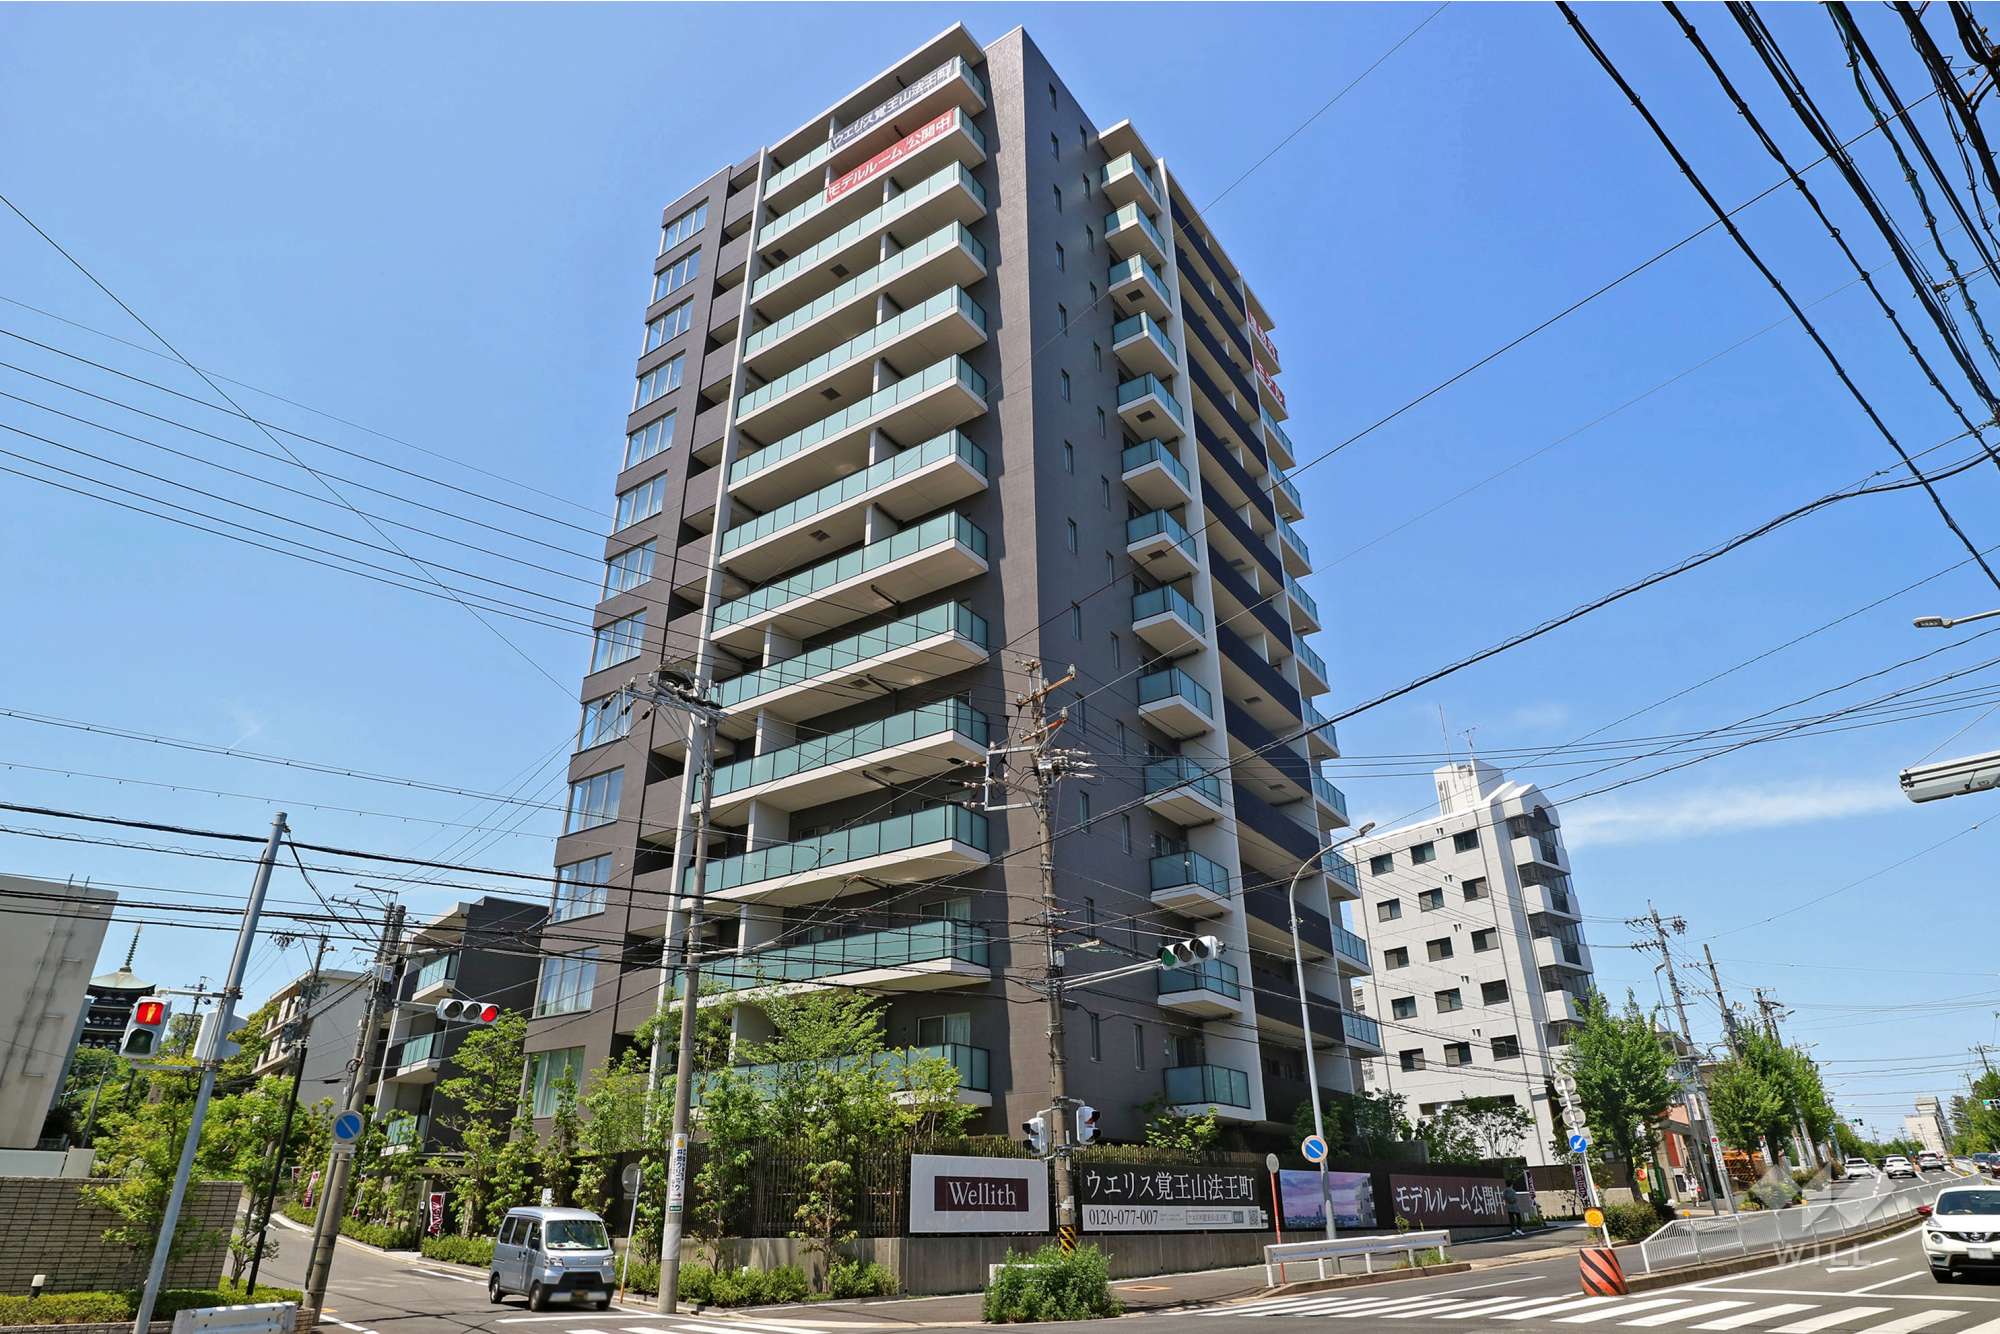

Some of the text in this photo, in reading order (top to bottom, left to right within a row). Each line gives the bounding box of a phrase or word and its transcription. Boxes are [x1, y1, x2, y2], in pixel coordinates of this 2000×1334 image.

[948, 1181, 1017, 1206] Wellith
[1086, 1170, 1255, 1200] ウエリス覚王山法王町
[1396, 1185, 1506, 1215] モデルルーム公開中
[1088, 1209, 1158, 1225] 0120-077-007
